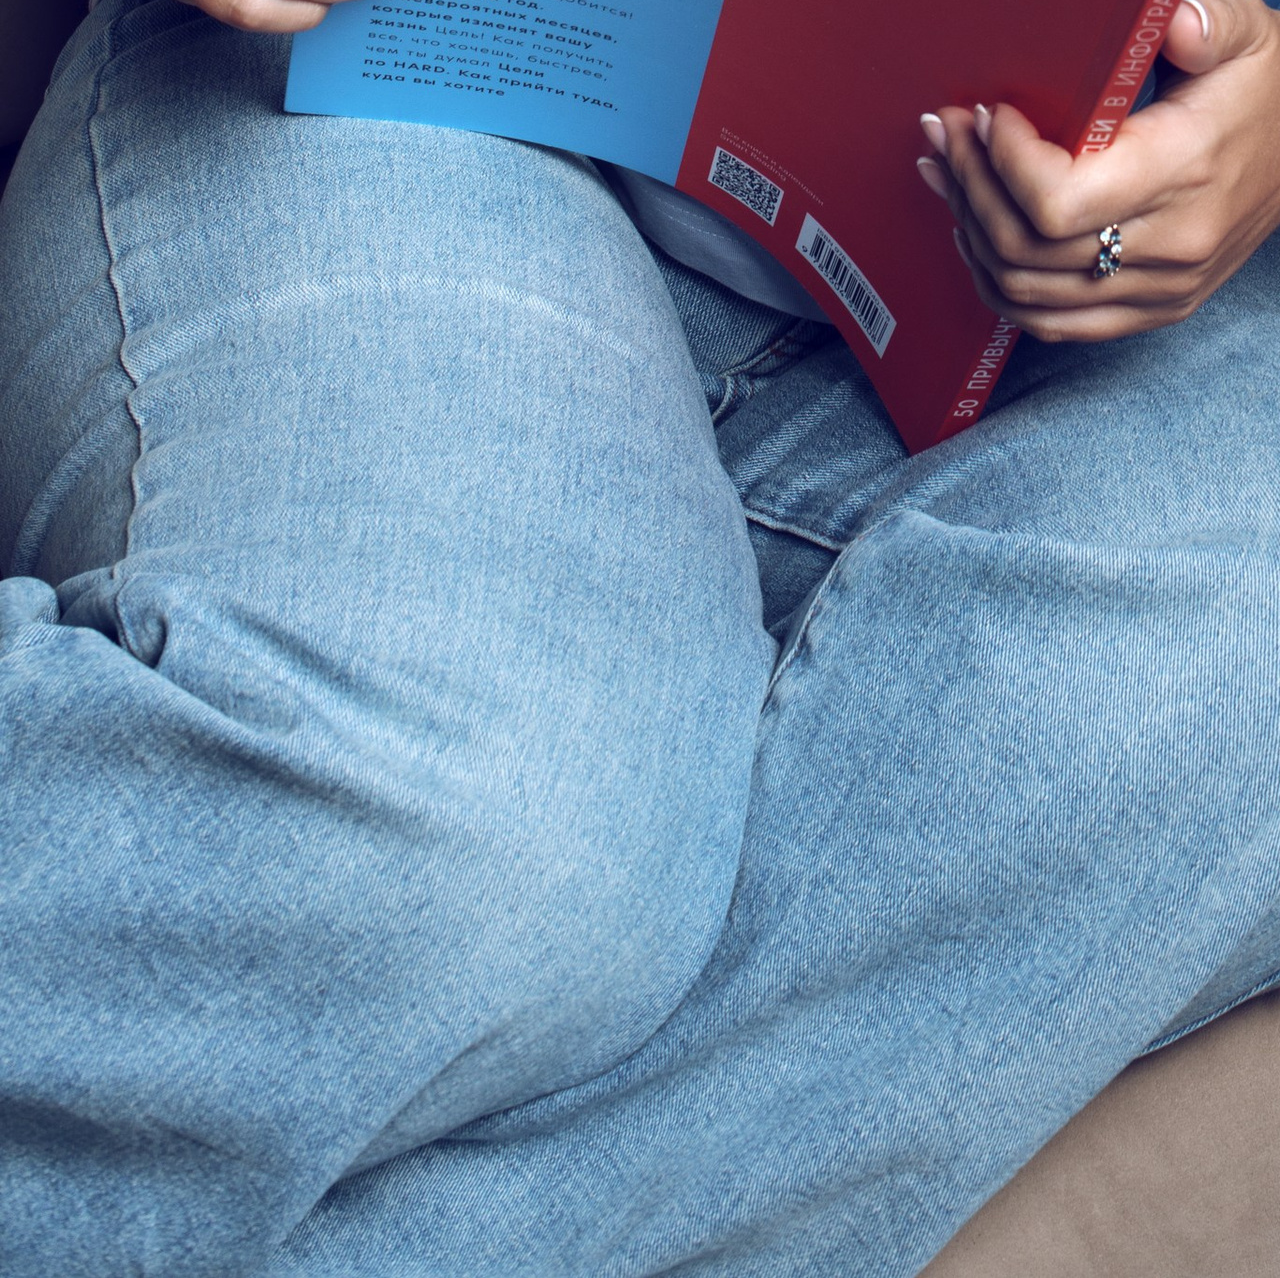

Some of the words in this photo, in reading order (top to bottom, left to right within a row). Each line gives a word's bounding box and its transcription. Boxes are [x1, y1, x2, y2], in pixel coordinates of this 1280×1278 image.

[370, 19, 427, 31] жизнь
[436, 26, 484, 40] Цель!
[493, 35, 524, 47] Как
[532, 44, 613, 69] получить
[372, 5, 453, 21] которые
[460, 17, 538, 36] изменят
[545, 33, 592, 50] вашу
[534, 17, 617, 44] месяцев,
[366, 46, 398, 55] чем
[434, 54, 490, 67] думал
[498, 63, 544, 78] Цели
[368, 33, 402, 42] все,
[412, 38, 440, 47] что
[448, 43, 518, 60] хочешь,
[528, 55, 607, 81] быстрее,
[362, 72, 406, 82] куда
[413, 77, 436, 85] вы
[444, 81, 505, 96] хотите
[364, 59, 386, 67] по
[393, 61, 450, 75] HARD.
[458, 69, 492, 81] Как
[499, 77, 565, 96] прийти
[572, 93, 618, 111] туда,
[720, 133, 748, 153] Smart
[750, 151, 787, 183] Reading
[816, 228, 835, 248] ISBN
[953, 399, 979, 417] 50
[966, 316, 1017, 390] ПРИВЫЧ
[1104, 96, 1128, 107] В
